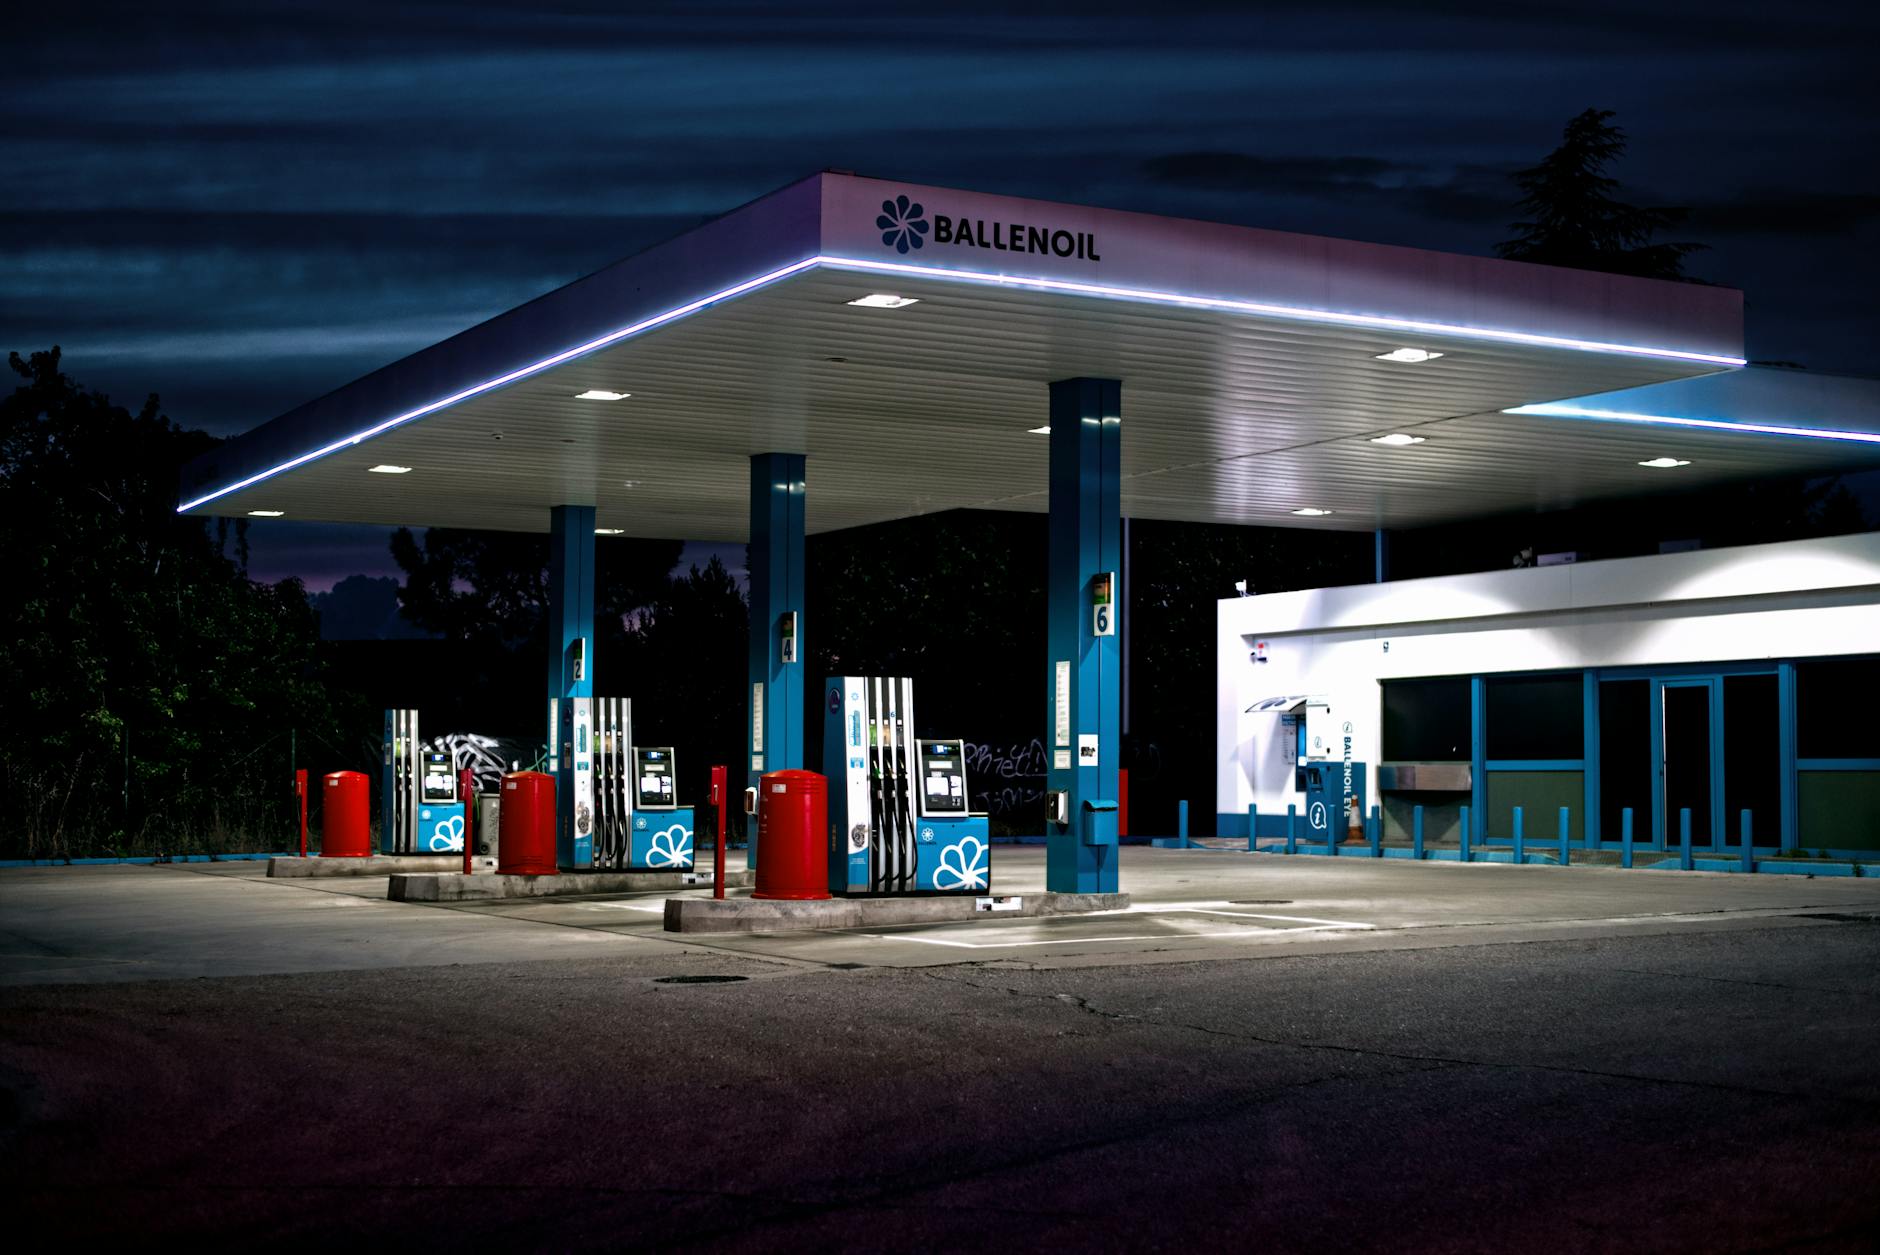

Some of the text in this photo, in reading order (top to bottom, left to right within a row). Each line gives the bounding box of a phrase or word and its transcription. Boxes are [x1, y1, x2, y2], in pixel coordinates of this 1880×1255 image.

[934, 214, 1100, 261] BALLENOIL
[1097, 606, 1108, 633] 6
[784, 639, 792, 661] 4
[575, 661, 581, 679] 2
[1344, 736, 1352, 795] BALLENOIL
[1344, 797, 1352, 818] EYE
